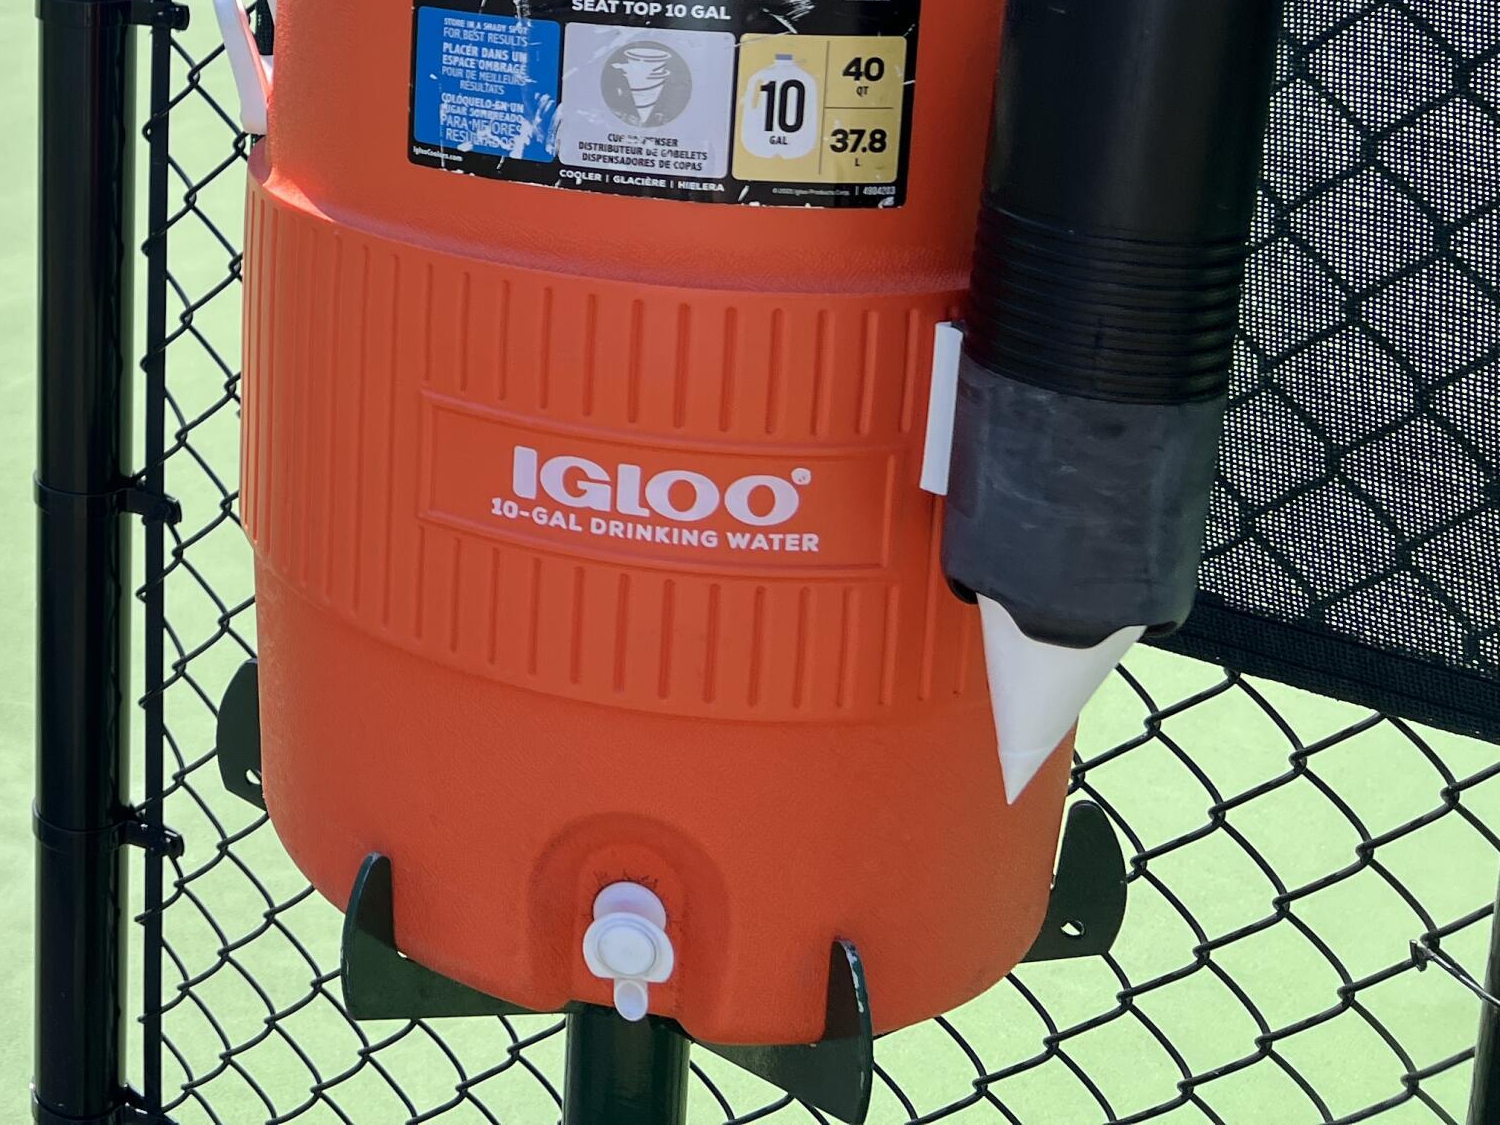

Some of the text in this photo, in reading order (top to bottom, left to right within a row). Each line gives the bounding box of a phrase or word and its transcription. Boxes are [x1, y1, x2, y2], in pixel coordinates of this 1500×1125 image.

[623, 1, 662, 16] TOP
[665, 4, 687, 17] 10
[690, 4, 731, 20] GAL
[443, 27, 528, 47] FOR BEST RESULTS
[442, 54, 476, 69] ESPACE
[482, 47, 509, 62] DANS
[512, 51, 528, 63] UN
[442, 66, 526, 86] POUR DE MEILLEURS
[842, 57, 885, 81] 40
[856, 86, 869, 97] QT
[510, 102, 524, 113] UN
[760, 79, 805, 133] 10
[441, 114, 468, 129] PARA
[579, 141, 642, 155] DISTRIBUTEUR
[769, 135, 788, 145] GAL
[830, 129, 887, 153] 37.8
[582, 153, 703, 171] DISPENSADORES DE COPAS
[854, 158, 860, 167] L
[559, 169, 725, 192] COOLER GLACIÈRE HIELERA
[512, 445, 800, 526] IGLOO
[491, 496, 819, 553] 10-GAL DRINKING WATER
